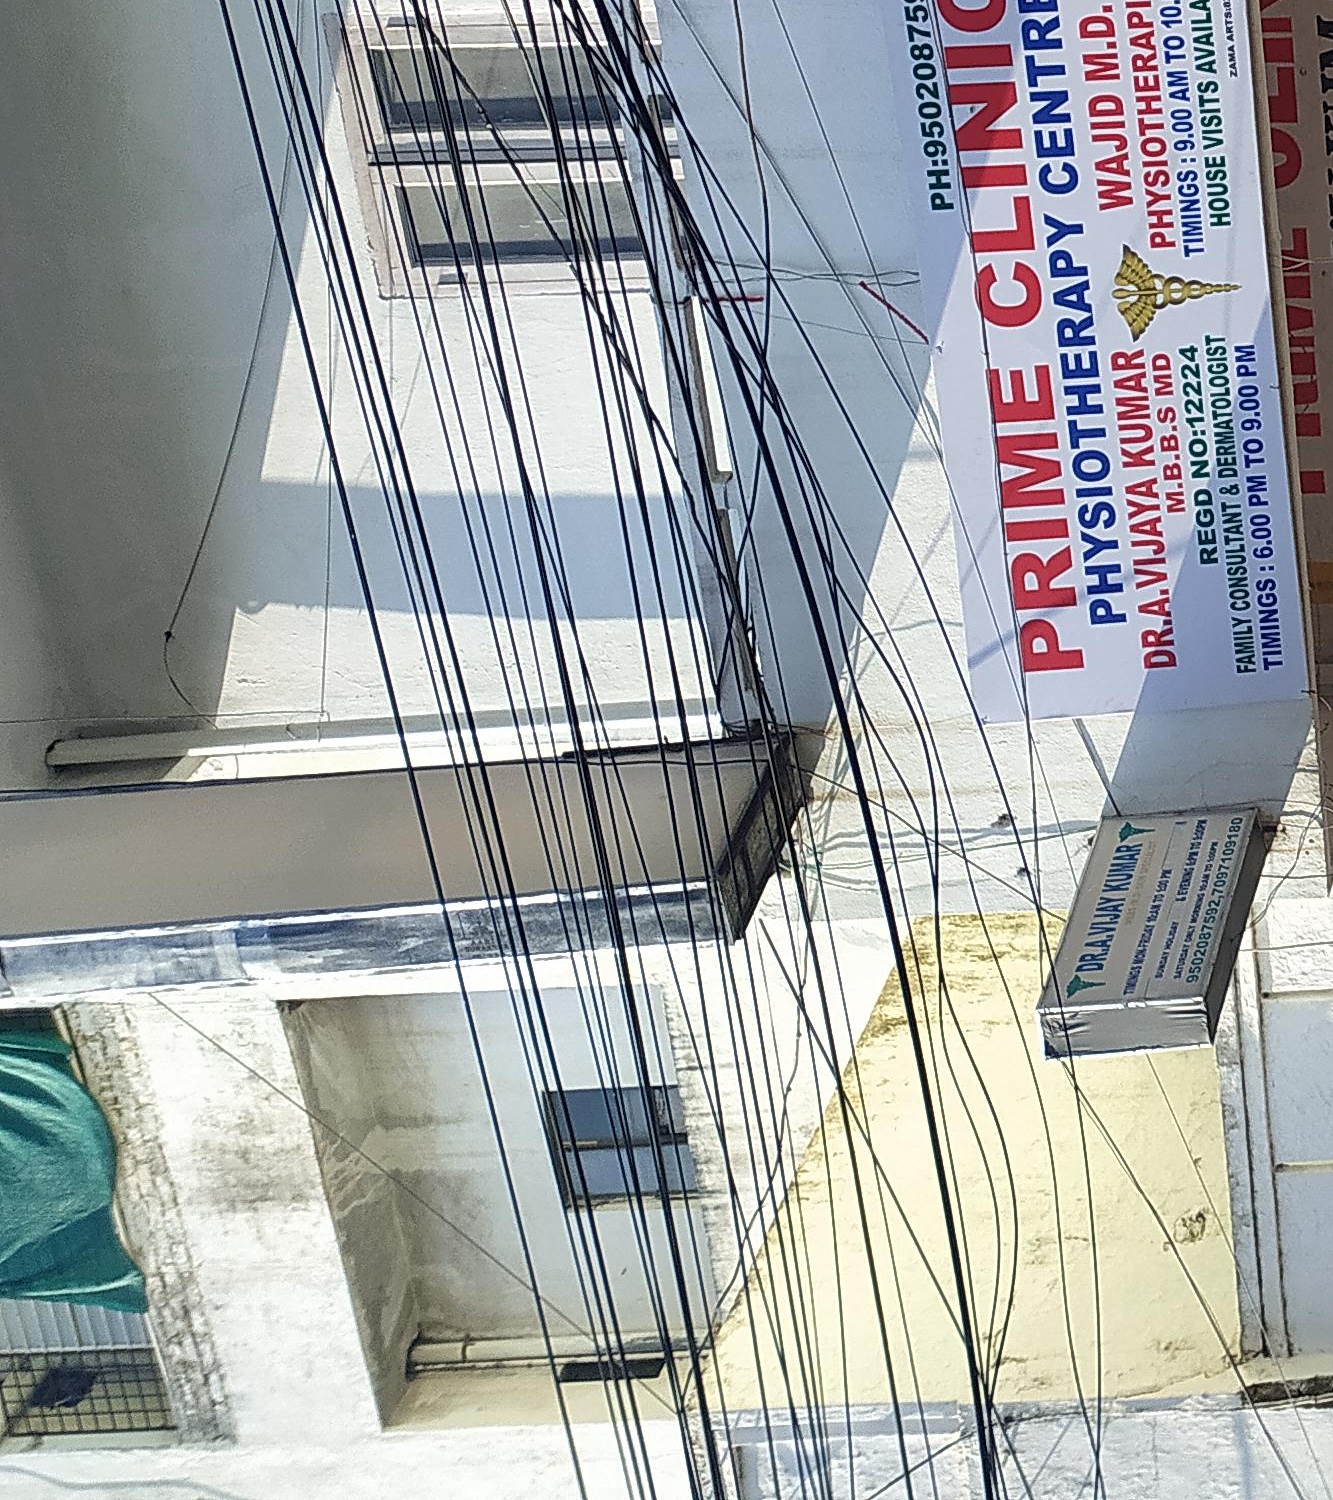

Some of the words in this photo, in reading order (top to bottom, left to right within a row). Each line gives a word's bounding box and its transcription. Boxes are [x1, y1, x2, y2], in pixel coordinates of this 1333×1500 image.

[1078, 4, 1121, 82] M.D.
[1163, 35, 1186, 64] TO
[1228, 45, 1239, 78] ZAMA
[1167, 70, 1191, 102] AM
[1197, 81, 1224, 150] VISITS
[1087, 94, 1134, 211] WAJID
[1170, 109, 1196, 151] 9.00
[1176, 169, 1205, 257] TIMINGS
[1204, 155, 1232, 227] HOUSE
[1151, 353, 1174, 397] MD
[1234, 344, 1257, 377] PM
[1043, 213, 1128, 626] PHYSIOTHERAPY
[1110, 349, 1156, 468] KUMAR
[1178, 345, 1210, 479] NO:12224
[1205, 335, 1237, 478] DERMATOLOGIST
[1239, 385, 1262, 430] 9.00
[1156, 406, 1186, 514] M.B.B.S
[1243, 438, 1265, 468] TO
[985, 364, 1084, 672] PRIME
[1220, 484, 1239, 495] &
[1247, 475, 1269, 507] PM
[1193, 489, 1219, 565] REGD
[1221, 502, 1251, 611] CONSULTANT
[1251, 513, 1275, 559] 6.00
[1124, 478, 1178, 669] DR.A.VIJAYA
[1231, 617, 1257, 674] FAMILY
[1256, 579, 1284, 671] TIMINGS
[1099, 843, 1143, 893] KUMAR
[1075, 896, 1127, 973] DR.A.VIJAY
[1123, 965, 1142, 995] TIMINGS
